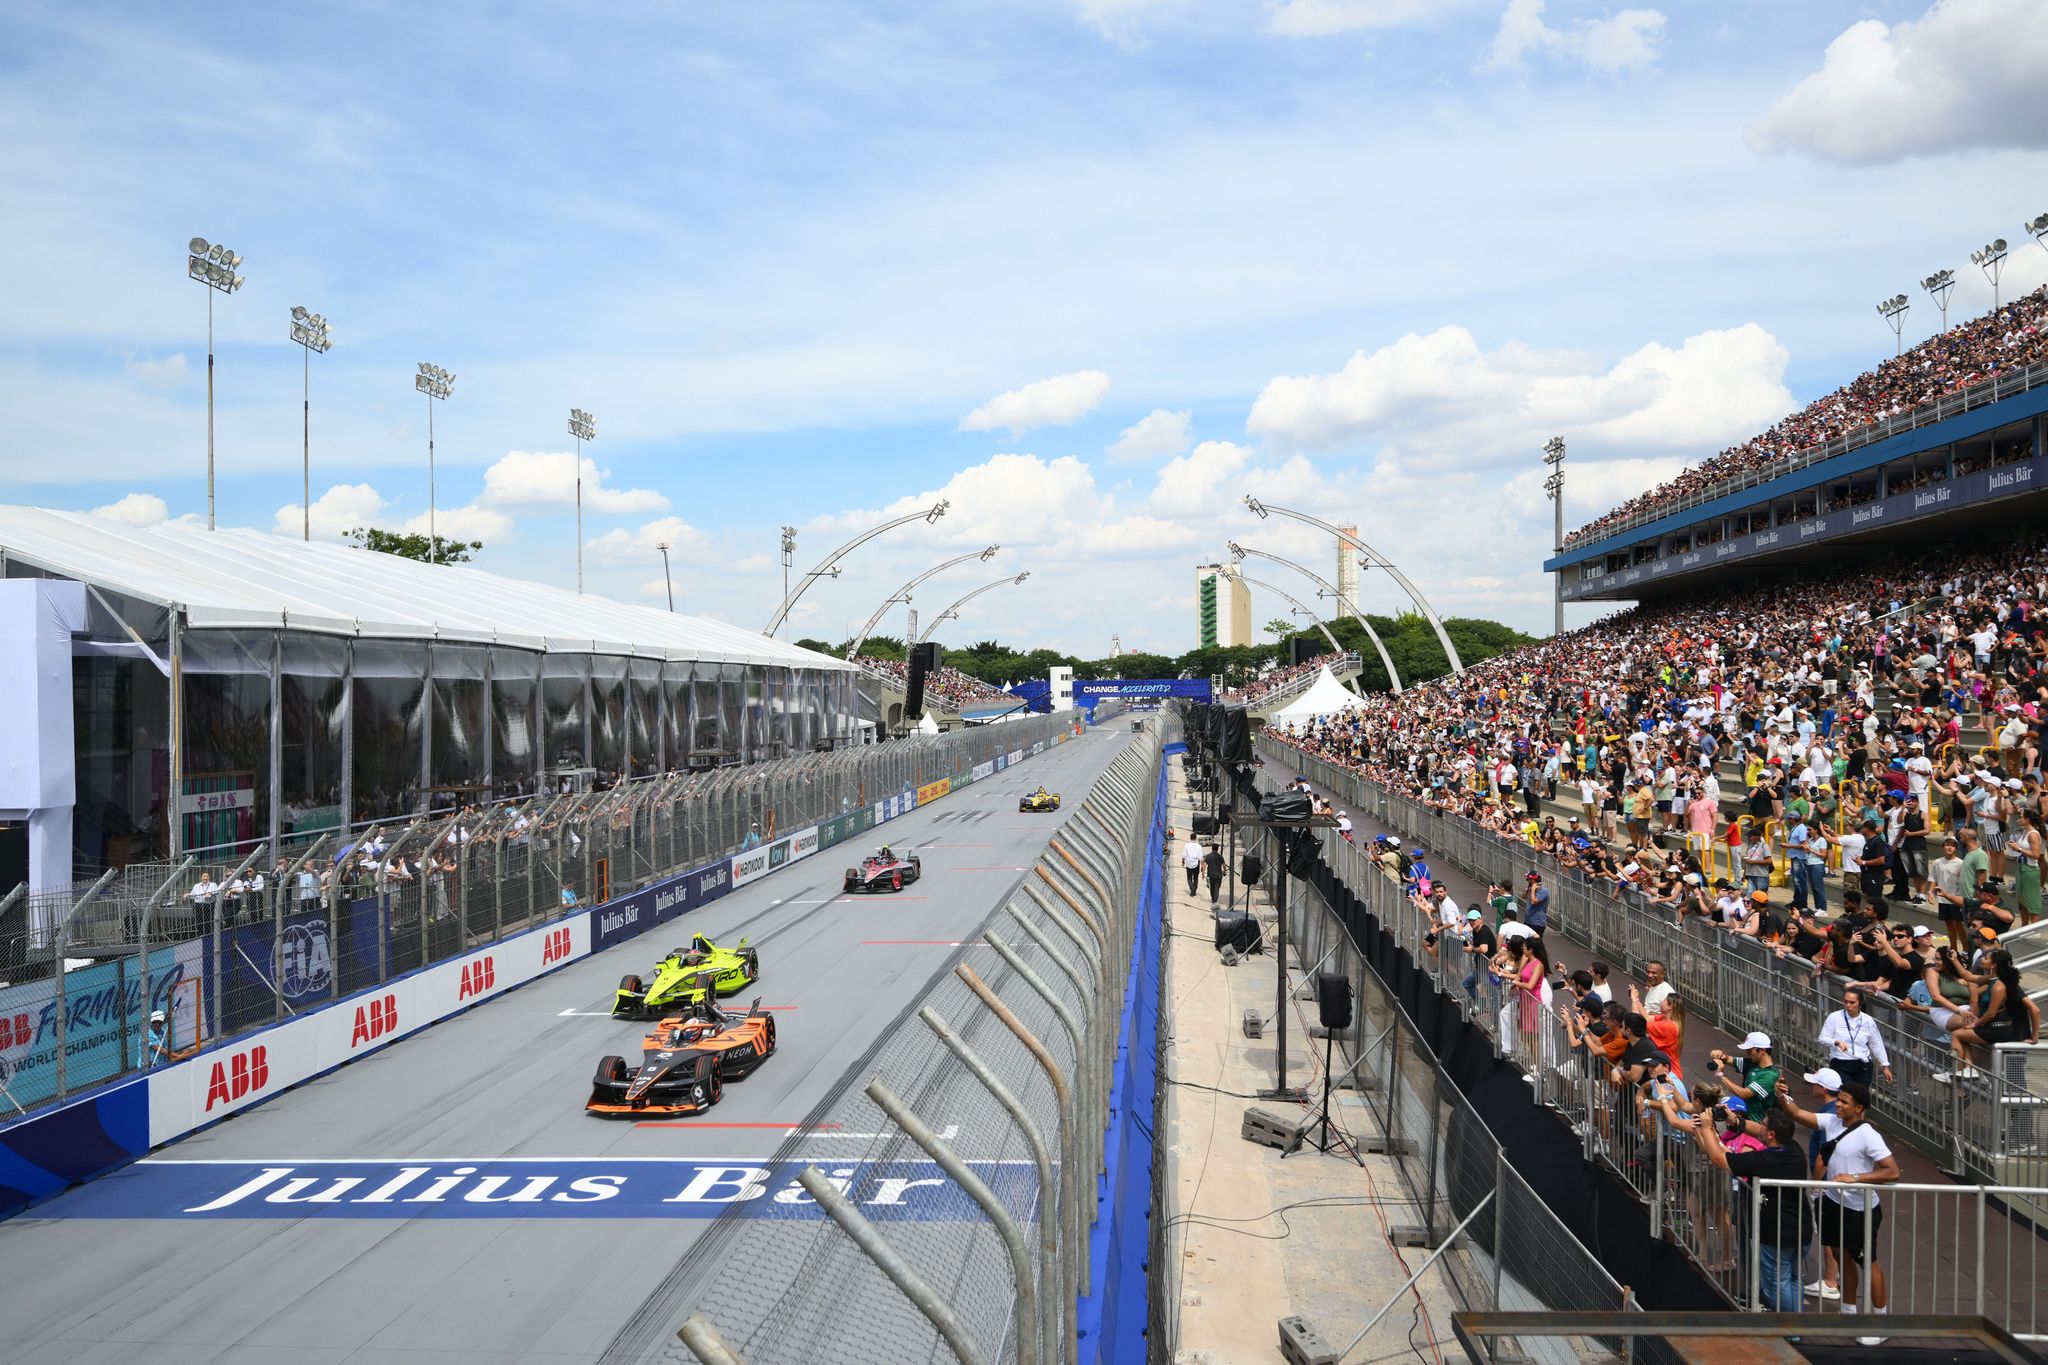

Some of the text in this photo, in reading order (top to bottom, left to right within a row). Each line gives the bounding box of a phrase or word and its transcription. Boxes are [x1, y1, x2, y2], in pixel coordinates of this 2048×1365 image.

[1989, 466, 2033, 492] Julius Bär
[1915, 487, 1951, 510] Julius Bär
[1800, 520, 1827, 539] Julius Bär
[1852, 505, 1884, 526] Julius Bär
[1756, 532, 1779, 549] Julius Bär
[700, 868, 727, 896] Julius Bär
[655, 885, 687, 916] Julius Bär
[600, 904, 639, 939] Julius Bär
[543, 927, 571, 966] ABB
[459, 956, 495, 1001] ABB
[713, 968, 739, 983] KIRO
[0, 1013, 32, 1051] BB
[351, 994, 398, 1048] ABB
[726, 1046, 752, 1060] NEOM
[205, 1045, 269, 1112] ABB
[183, 1166, 629, 1213] Julius
